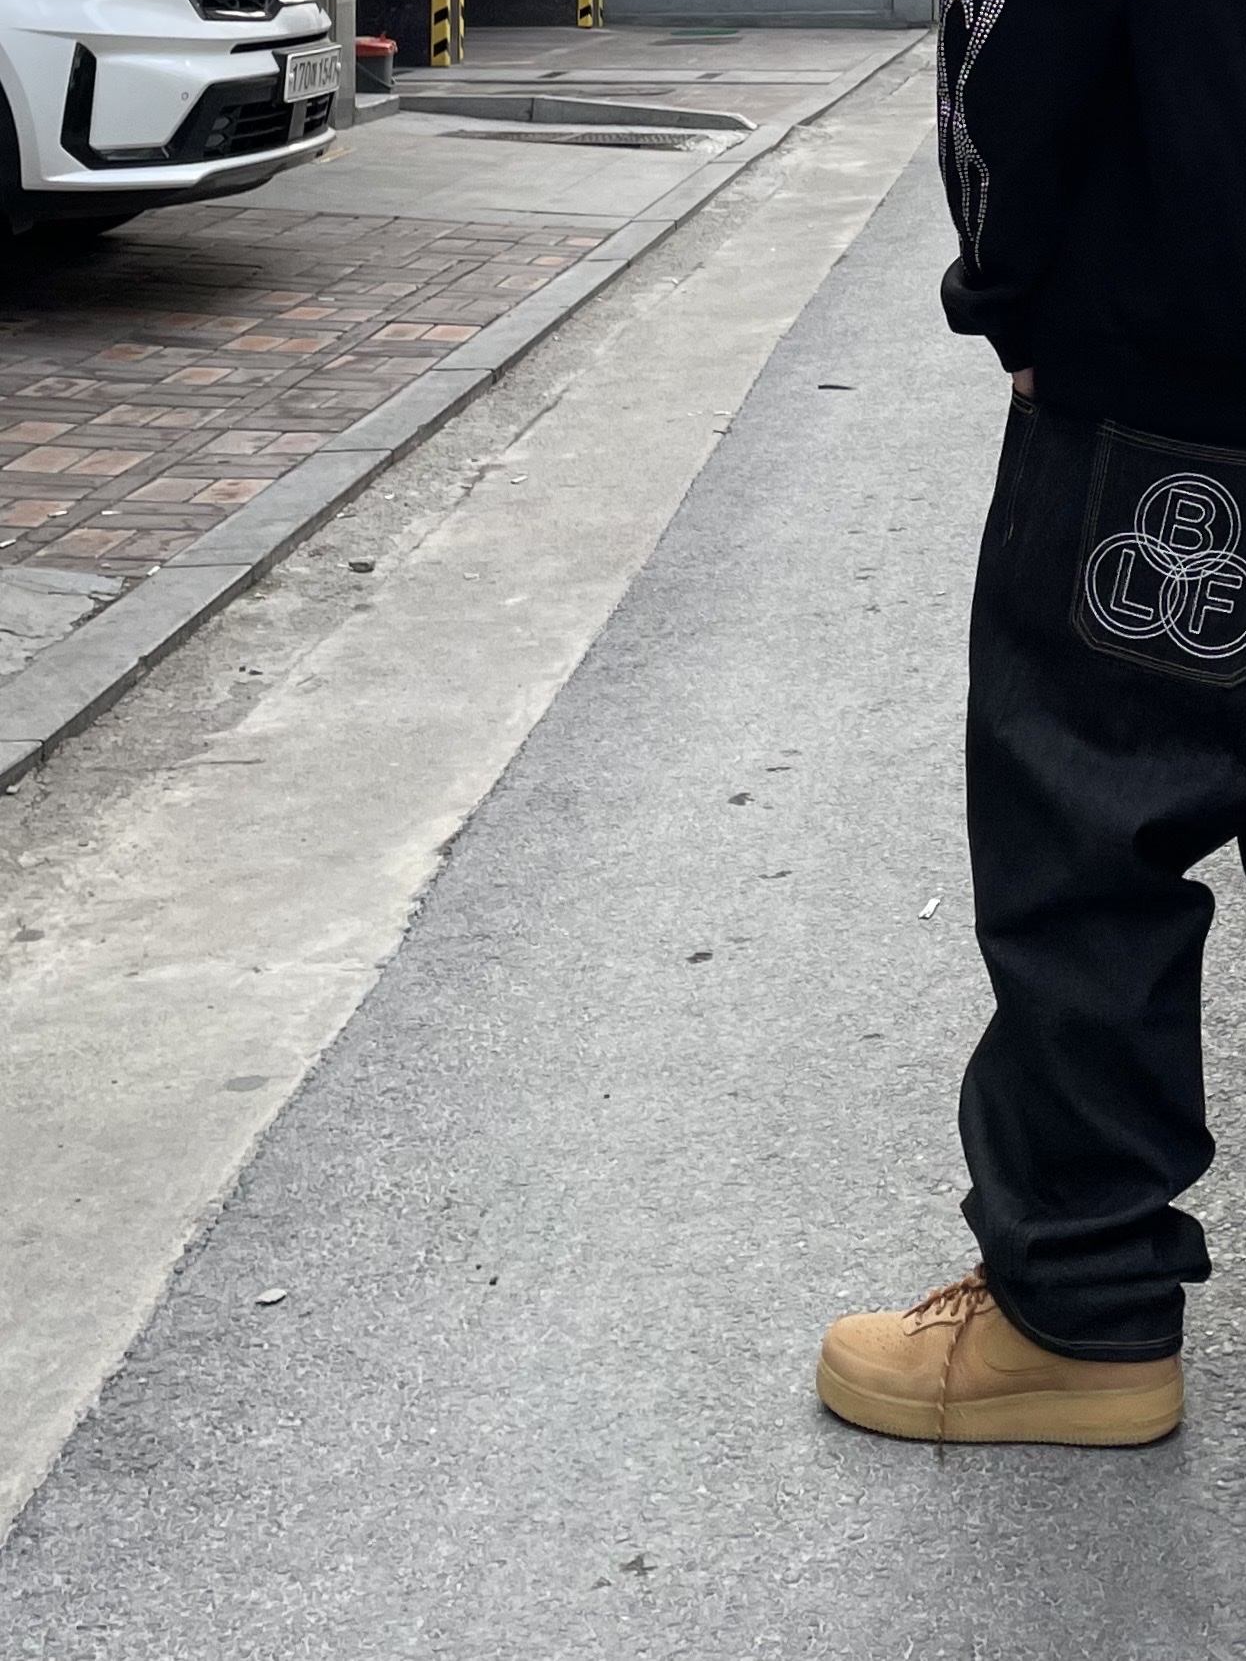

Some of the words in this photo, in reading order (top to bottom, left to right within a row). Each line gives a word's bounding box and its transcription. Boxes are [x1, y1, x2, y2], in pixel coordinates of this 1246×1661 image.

[1158, 488, 1217, 560] B
[1110, 548, 1154, 621] L
[1188, 569, 1243, 635] F
